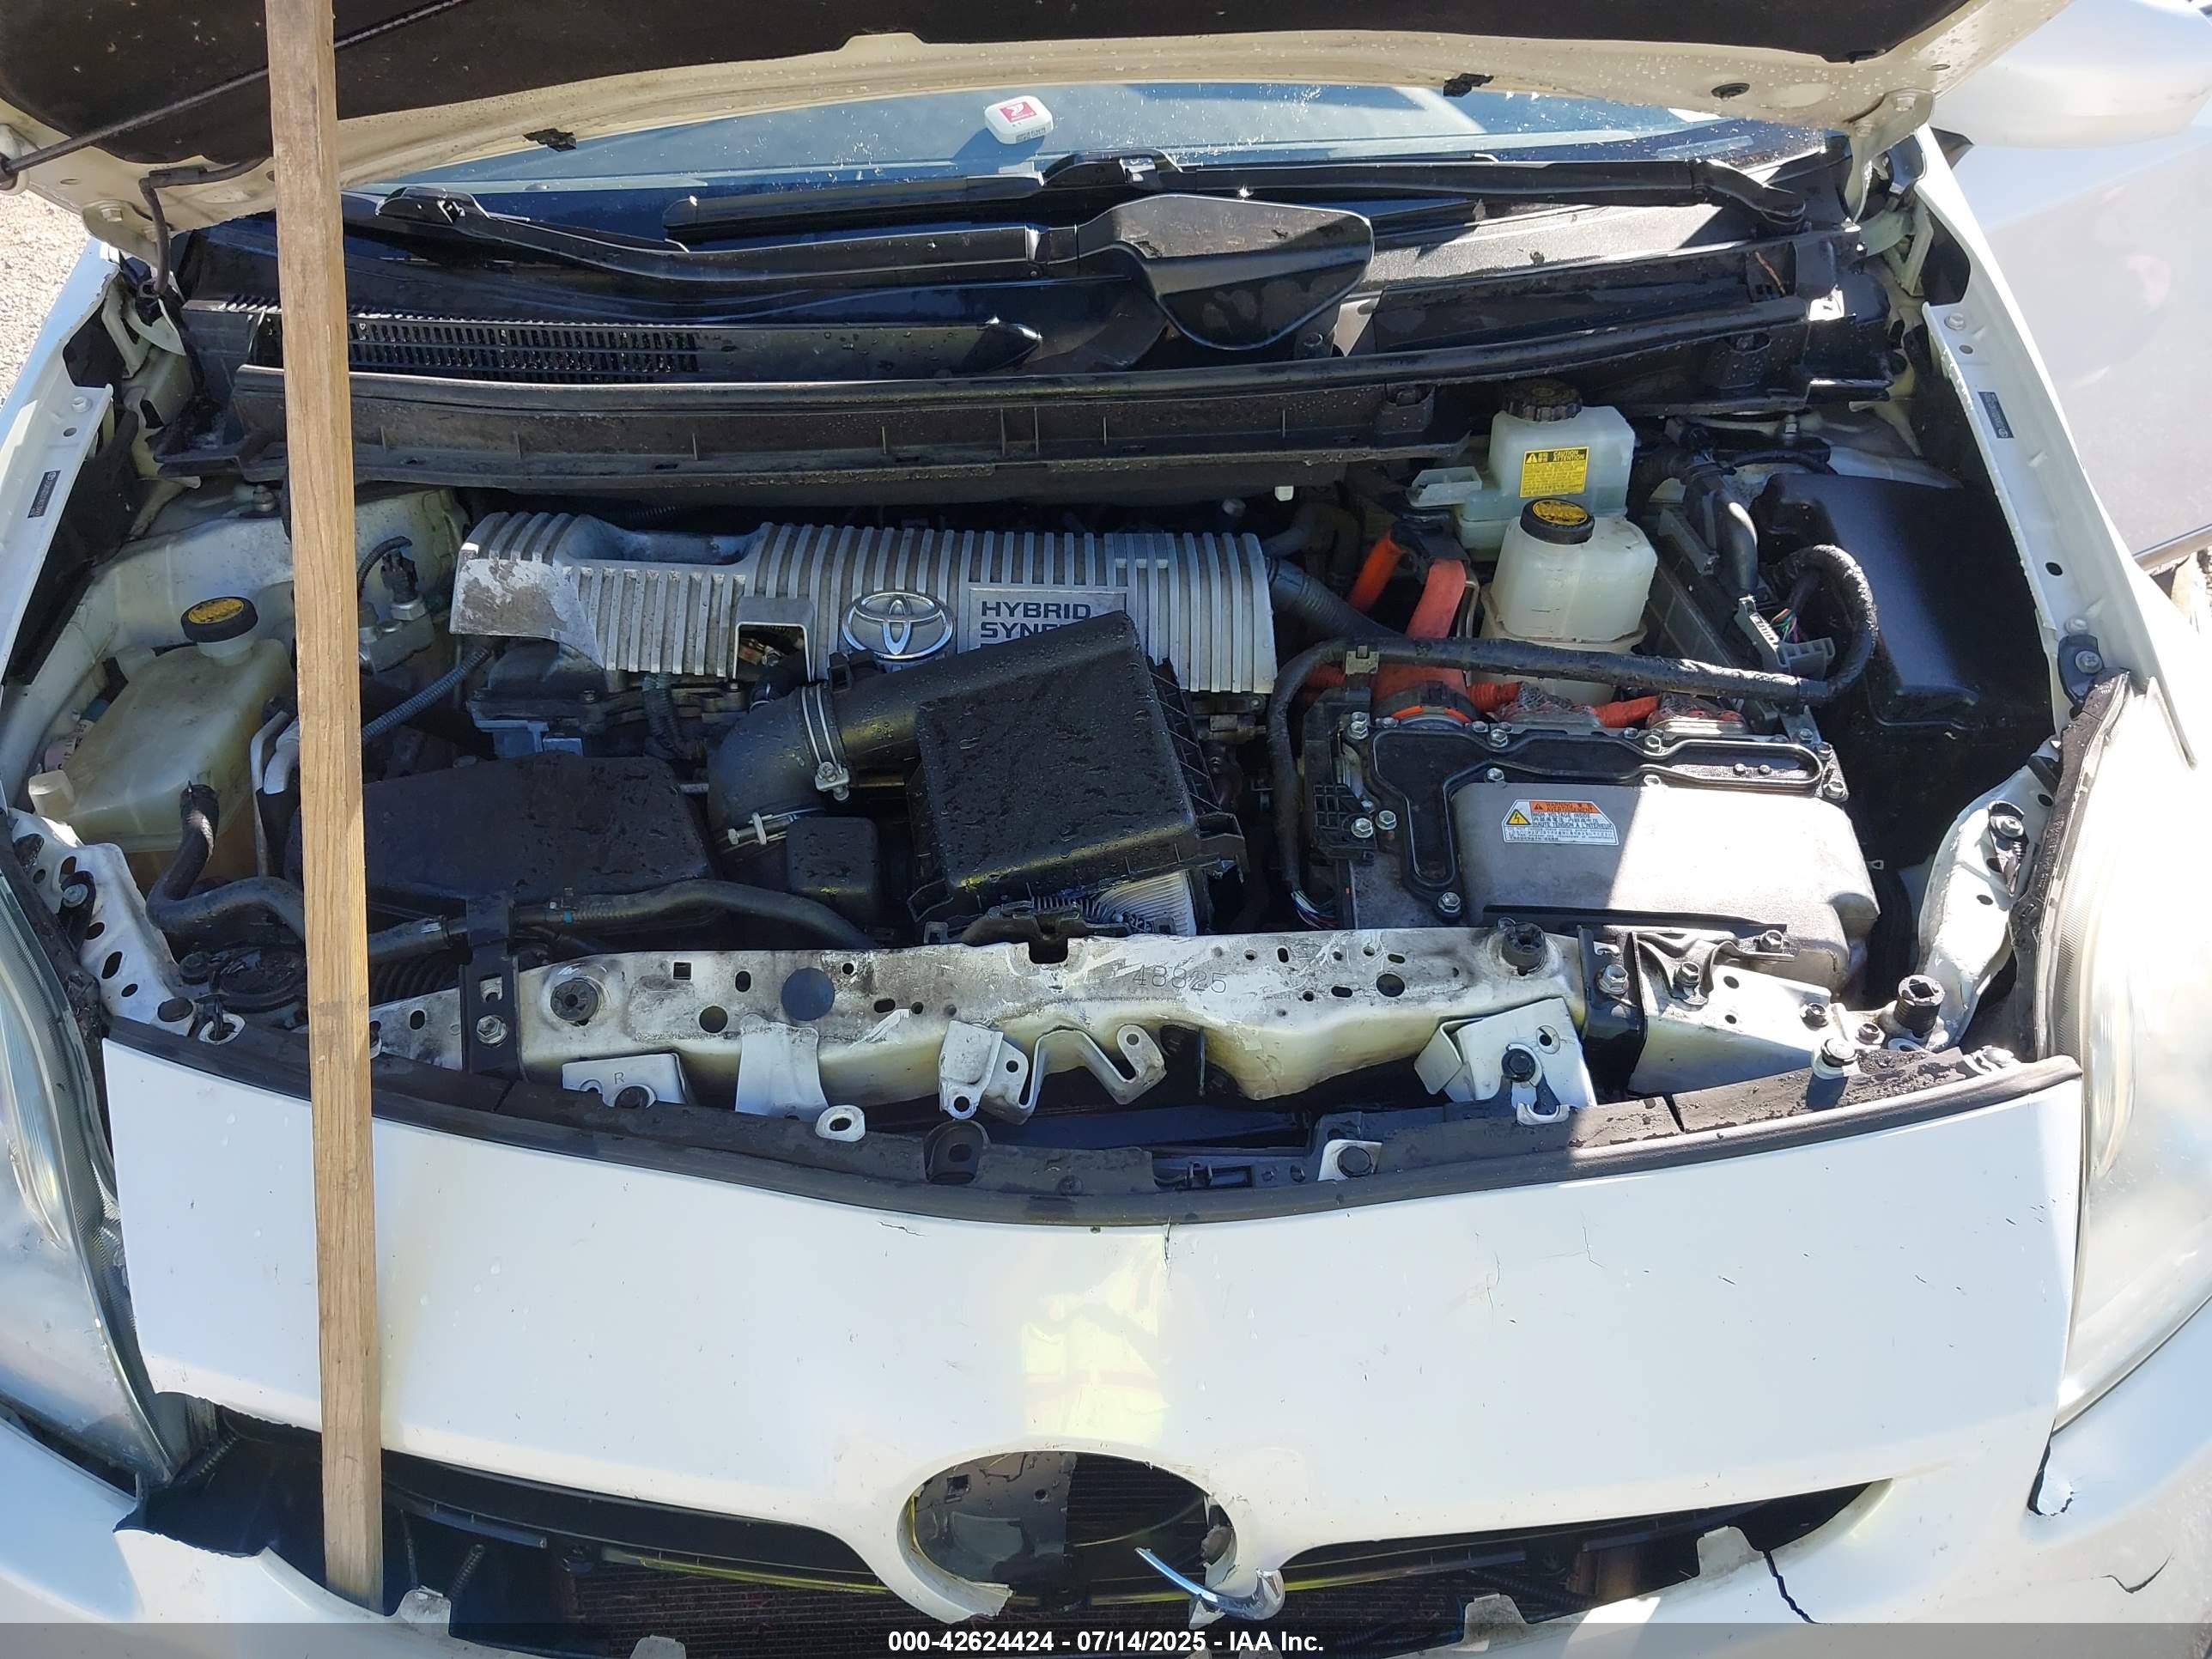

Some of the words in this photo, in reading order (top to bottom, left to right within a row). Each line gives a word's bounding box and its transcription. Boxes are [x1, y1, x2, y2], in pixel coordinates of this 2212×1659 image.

[981, 601, 1091, 619] HYBRID
[1133, 964, 1227, 993] 48825
[614, 1072, 625, 1085] R
